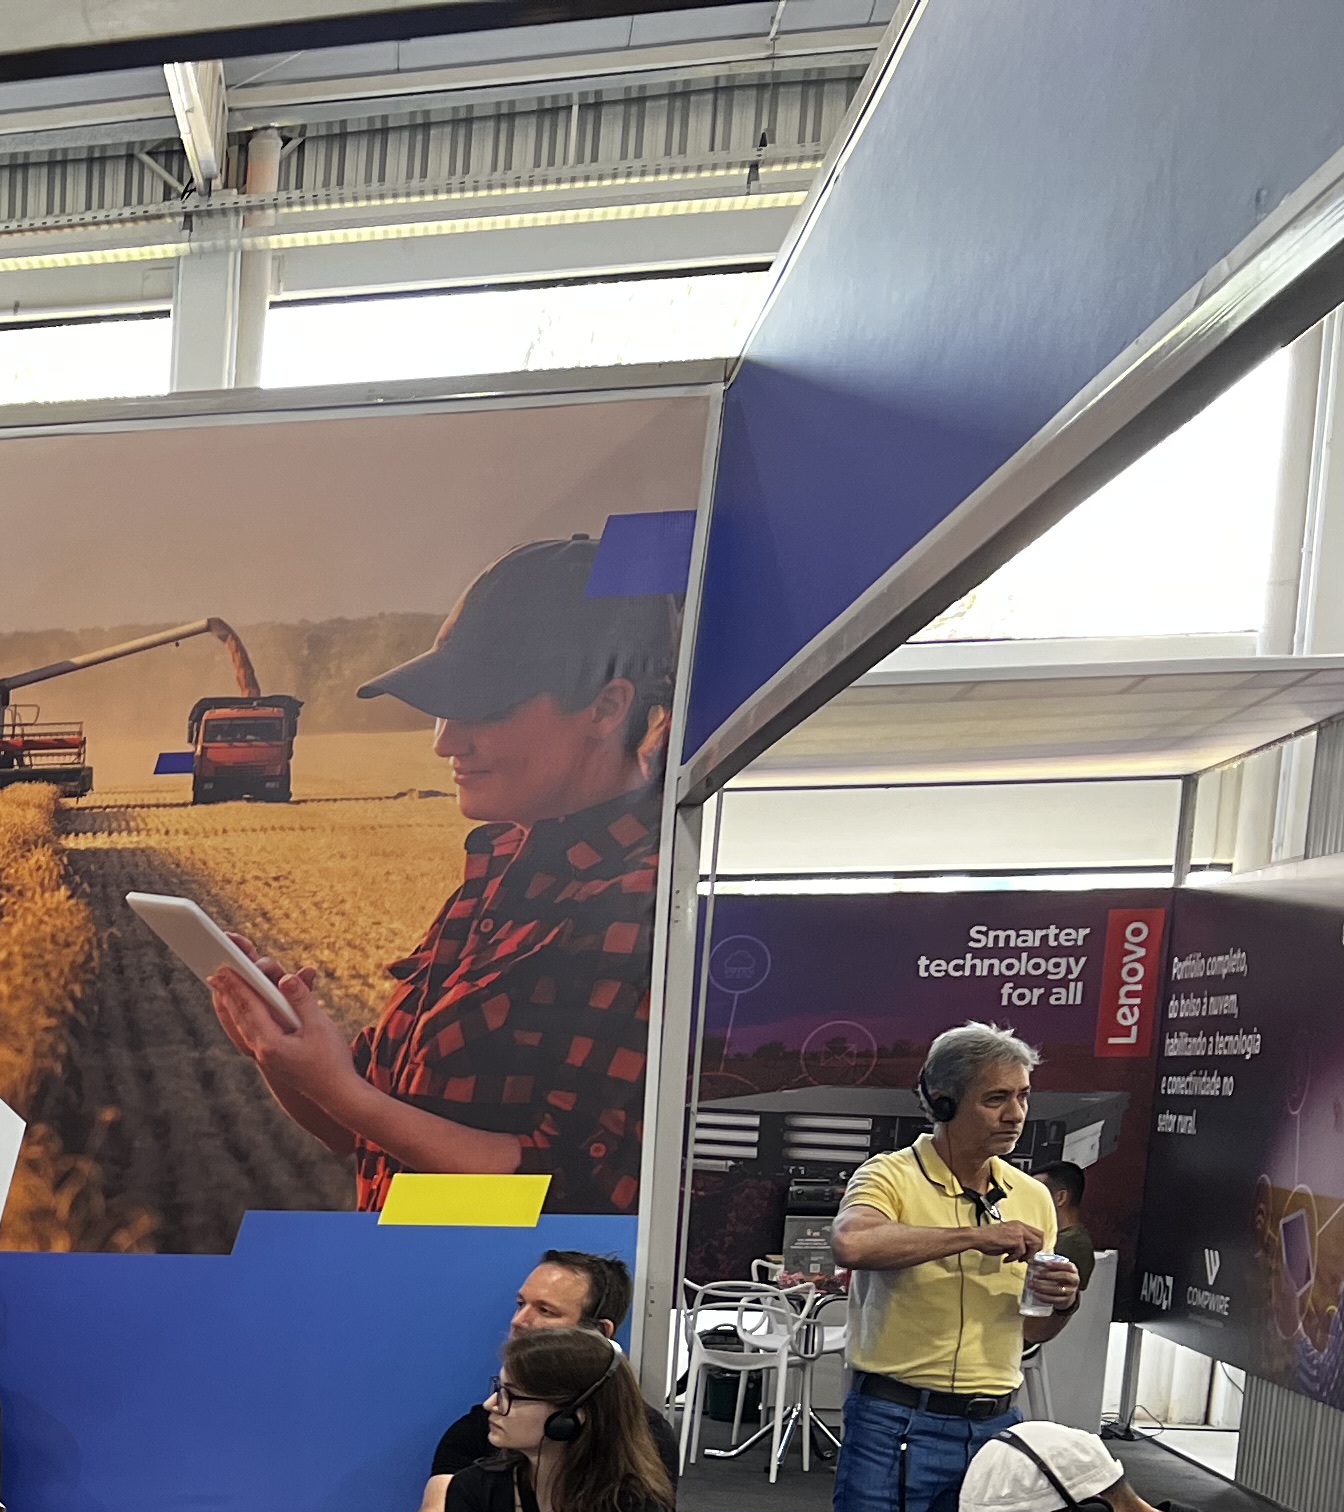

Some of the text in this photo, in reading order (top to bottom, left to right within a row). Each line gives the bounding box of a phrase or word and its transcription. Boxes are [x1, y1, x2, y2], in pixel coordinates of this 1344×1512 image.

[968, 925, 1090, 948] Smarter
[918, 952, 1087, 980] technology
[1000, 981, 1083, 1006] for all
[1107, 921, 1149, 1045] Lenovo
[1168, 994, 1178, 1018] do
[1180, 992, 1201, 1017] bolso
[1215, 1027, 1261, 1059] tecnologia
[1167, 1069, 1221, 1096] conectividade
[1141, 1272, 1164, 1305] AMD
[1187, 1286, 1230, 1316] COMPWIRE
